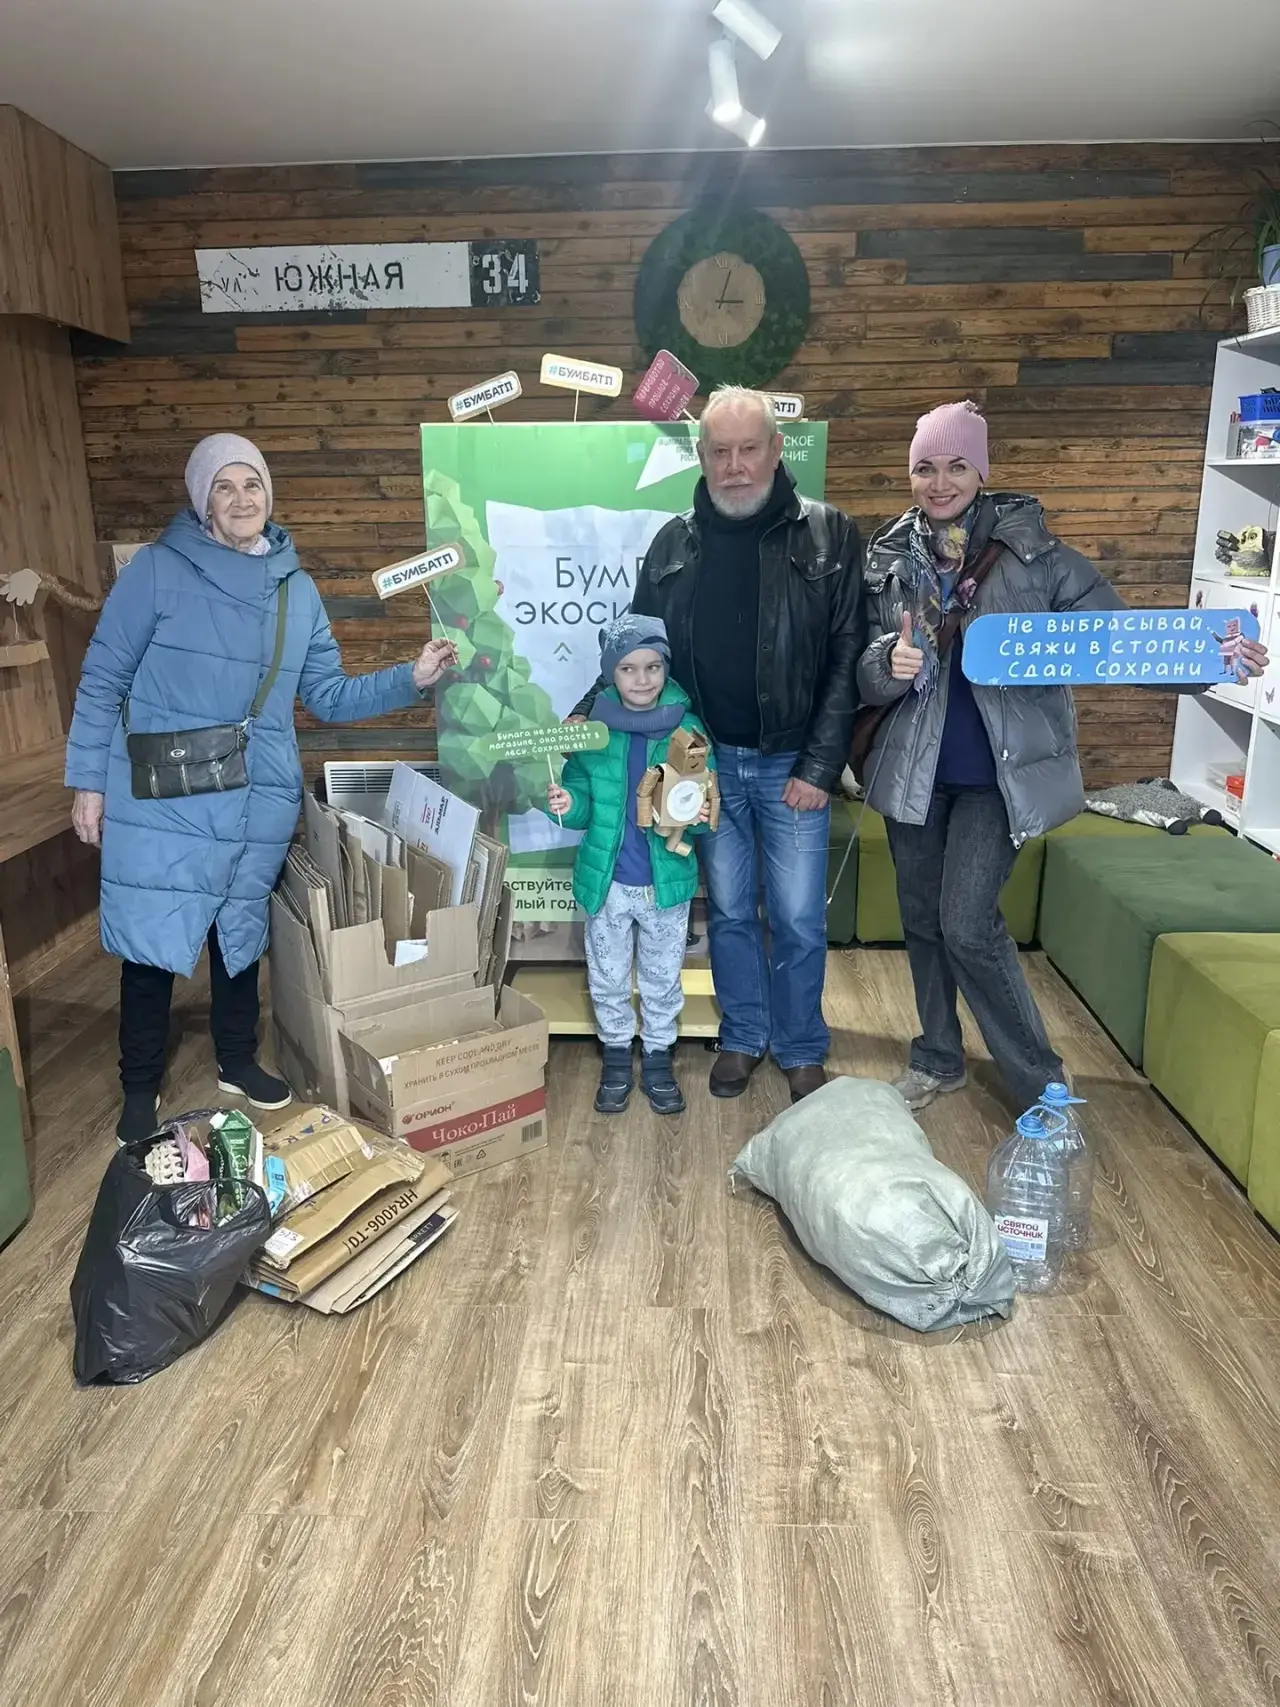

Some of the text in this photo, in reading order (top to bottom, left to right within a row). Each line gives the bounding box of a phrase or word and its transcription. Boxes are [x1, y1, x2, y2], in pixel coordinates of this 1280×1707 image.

[275, 262, 404, 293] ЮЖНАЯ
[482, 254, 529, 295] 34
[783, 435, 815, 447] СКОЕ
[781, 450, 809, 462] ЧИЕ
[556, 557, 645, 596] Бум
[515, 601, 632, 625] экоси
[1007, 616, 1034, 634] Не
[999, 639, 1077, 657] Свяжи
[1007, 660, 1203, 679] Сдай. Сохрани
[515, 896, 579, 912] лый год
[435, 1054, 457, 1068] KEEP
[403, 1074, 438, 1090] ХРАНИТЬ
[444, 1066, 471, 1080] СУХОМ
[413, 1103, 453, 1121] ОРИОН
[410, 1221, 434, 1242] ARKETT
[996, 1224, 1044, 1239] ИСТОЧНИК
[1002, 1219, 1040, 1232] СВЯТОЙ
